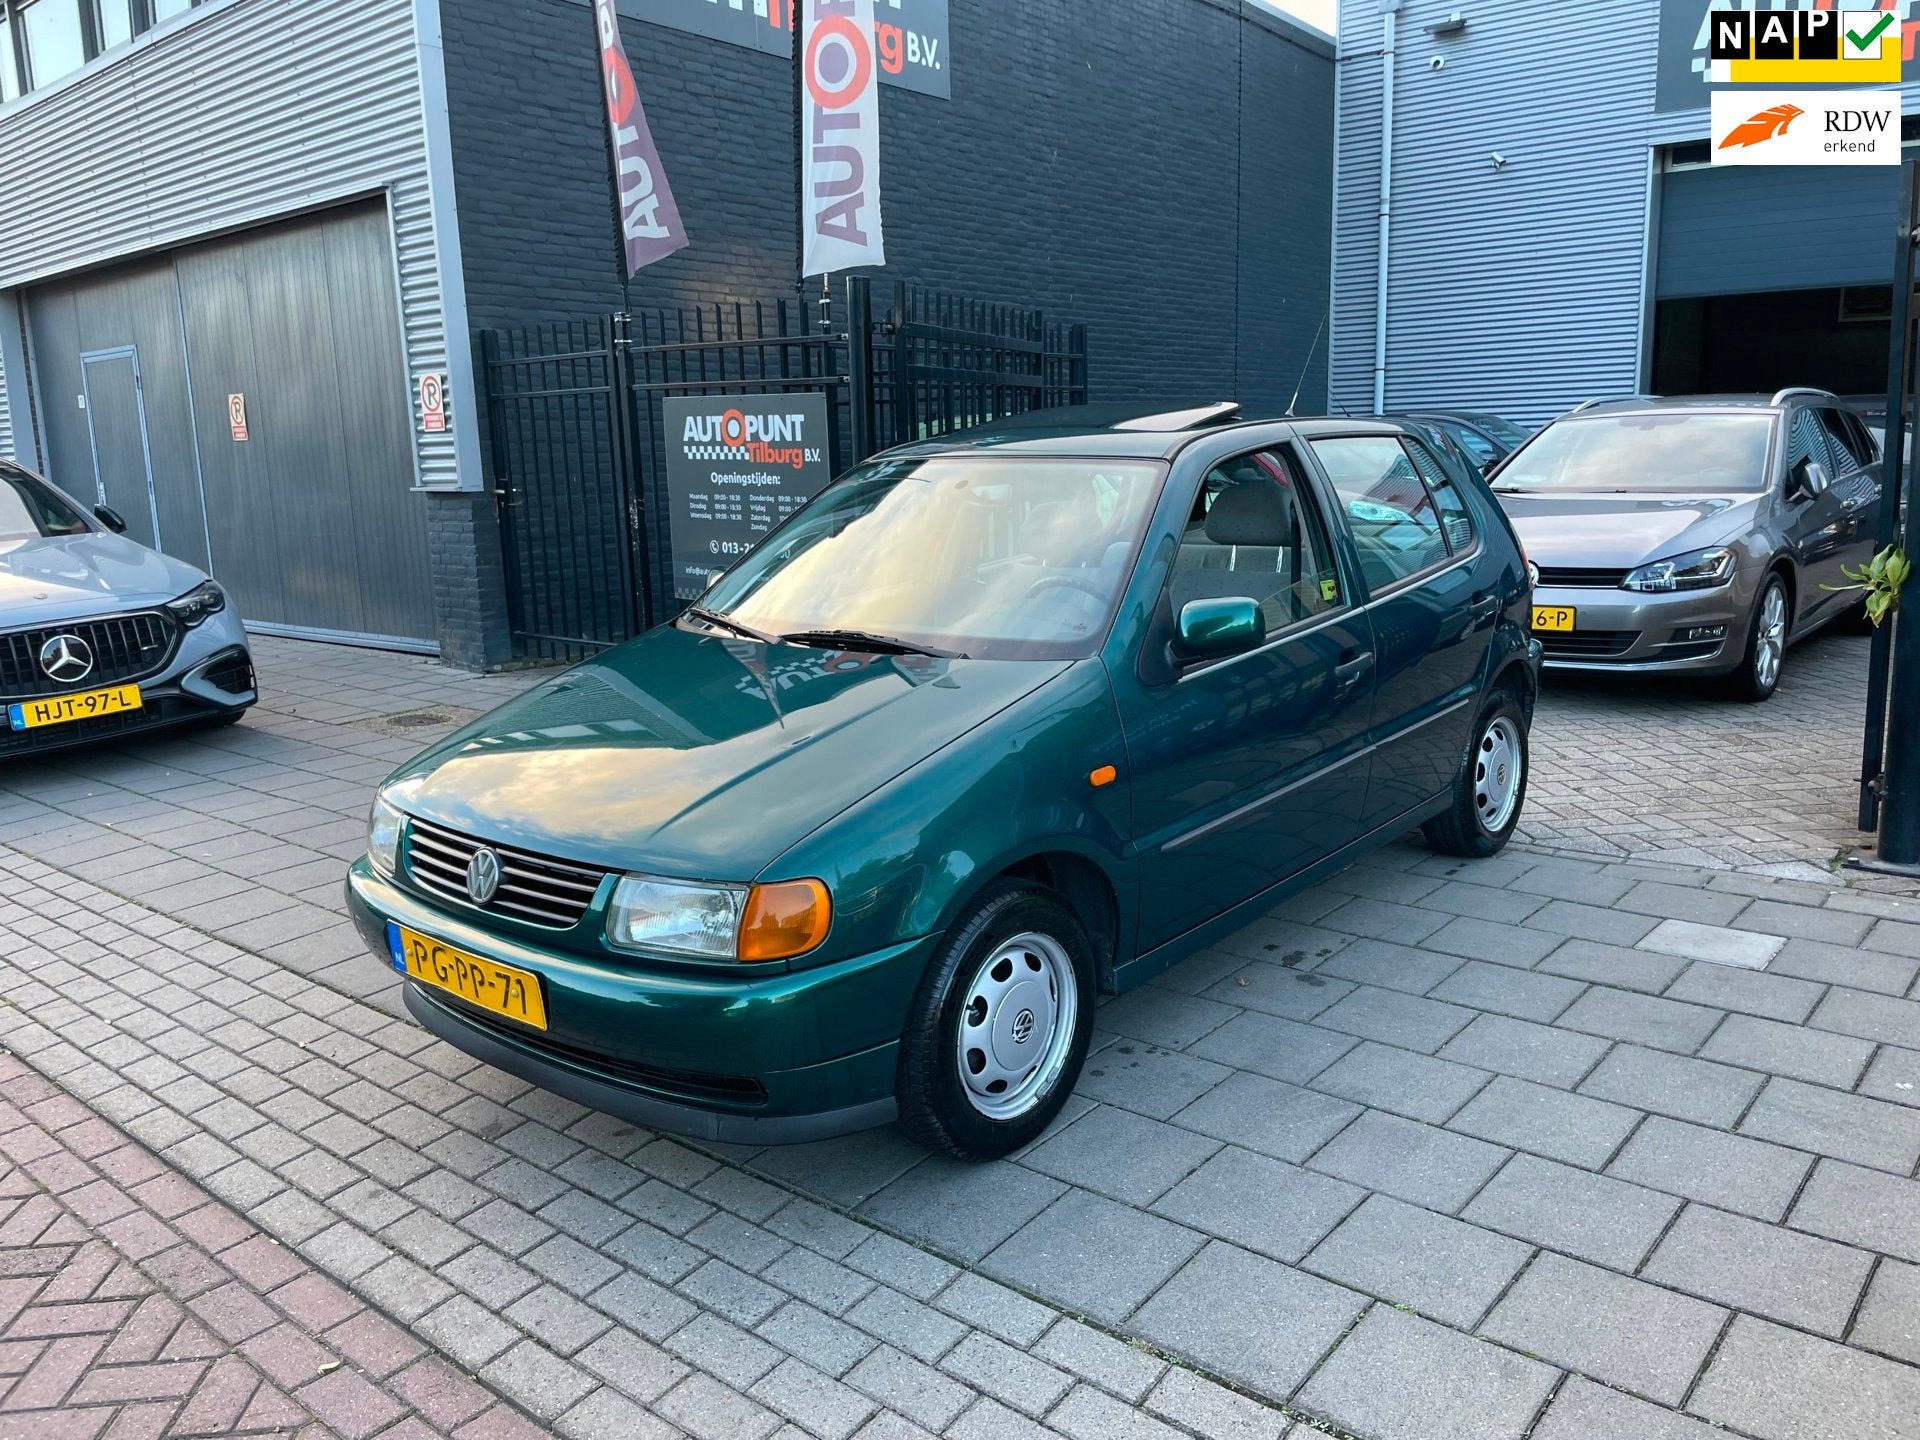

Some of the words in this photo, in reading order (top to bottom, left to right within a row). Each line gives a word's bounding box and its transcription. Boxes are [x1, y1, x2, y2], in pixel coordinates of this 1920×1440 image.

[907, 32, 940, 70] B.V.
[599, 0, 670, 240] AUTOP
[683, 409, 804, 447] AUTOPUNT
[746, 442, 803, 470] Tilburg
[805, 448, 821, 463] B.V.
[711, 472, 781, 486] Openingstijden:
[689, 493, 708, 501] Maandag
[749, 494, 774, 503] Donderdag
[722, 541, 755, 554] 013-2
[35, 691, 131, 722] HJT-97-L
[394, 952, 405, 964] NL
[413, 938, 527, 1016] PG-PP-71
